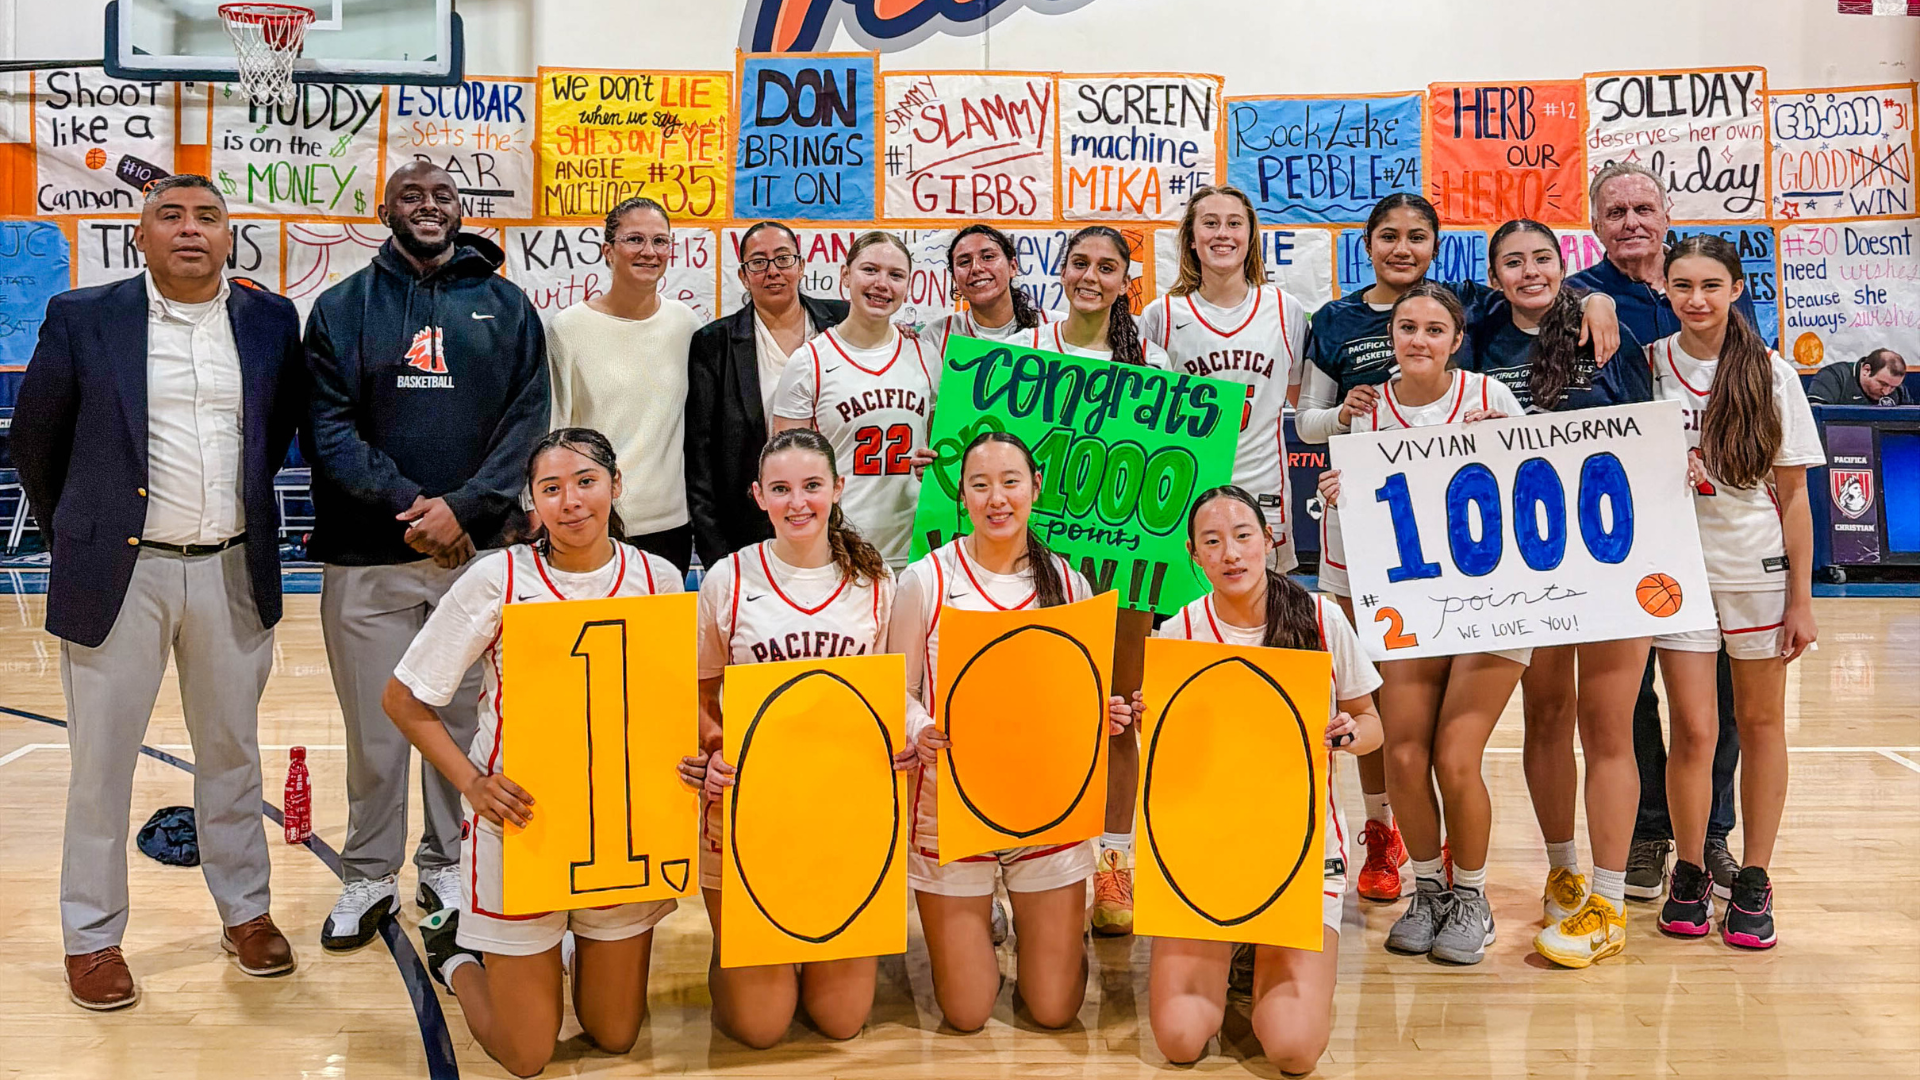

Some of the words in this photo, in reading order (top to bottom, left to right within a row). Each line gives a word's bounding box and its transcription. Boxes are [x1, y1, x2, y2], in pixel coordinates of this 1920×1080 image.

[397, 81, 525, 123] ESCOBAR
[660, 77, 712, 108] LIE
[755, 68, 857, 128] DON
[884, 75, 937, 135] SAMMY
[1077, 84, 1212, 132] SCREEN
[1595, 72, 1755, 122] SOLIDAY
[579, 105, 623, 125] when
[628, 112, 648, 125] we
[652, 111, 683, 138] say
[912, 81, 1051, 149] SLAMMY
[1452, 86, 1536, 141] HERB
[1542, 101, 1578, 121] #12
[1882, 98, 1909, 131] #31
[53, 115, 109, 147] like
[124, 115, 155, 139] a
[223, 130, 243, 150] is
[250, 137, 281, 153] on
[289, 137, 322, 157] the
[411, 121, 464, 147] sets
[472, 122, 511, 151] the
[556, 125, 623, 156] SHE'S
[628, 130, 655, 154] ON
[660, 115, 726, 162] FYE!
[1070, 125, 1199, 169] machine
[1588, 127, 1681, 150] deserves
[1688, 122, 1719, 143] her
[1726, 124, 1764, 142] own
[744, 132, 864, 169] BRINGS
[885, 143, 915, 176] #1
[1506, 143, 1560, 169] OUR
[121, 159, 151, 181] #10
[247, 161, 358, 210] MONEY
[413, 152, 502, 188] AR
[555, 158, 625, 181] ANGIE
[1257, 153, 1384, 203] PEBBLE
[1383, 157, 1418, 189] #24
[38, 184, 134, 212] Cannon
[545, 180, 645, 216] Martinez
[647, 163, 716, 217] #35
[752, 175, 781, 208] IT
[794, 172, 841, 206] ON
[912, 173, 1037, 217] GIBBS
[1068, 164, 1162, 215] MIKA
[1441, 169, 1541, 221] HERO
[1849, 187, 1908, 216] WIN
[1783, 227, 1838, 257] #30
[1844, 226, 1912, 256] Doesnt
[1783, 261, 1827, 281] need
[1839, 258, 1920, 281] wishes
[1854, 284, 1887, 305] she
[1787, 312, 1847, 334] always
[1184, 349, 1276, 381] PACIFICA
[1348, 341, 1386, 355] PACIFICA
[1356, 350, 1396, 364] BASKETB
[397, 375, 454, 389] BASKETBALL
[1491, 370, 1520, 382] ACIFICA
[835, 388, 926, 424] PACIFICA
[948, 347, 1224, 440] Congrats
[853, 423, 913, 476] 22
[1377, 433, 1477, 464] VIVIAN
[1498, 416, 1642, 451] VILLAGRANA
[1834, 455, 1868, 465] PACIFICA
[1031, 427, 1199, 537] 1000
[1035, 519, 1141, 551] points
[1375, 452, 1635, 584] 1000
[1834, 524, 1875, 532] CHRISTIAN
[1429, 583, 1588, 640] points
[1457, 625, 1481, 640] WE
[1491, 618, 1534, 638] LOVE
[1540, 613, 1580, 633] YOU!
[731, 668, 900, 944] 0
[944, 623, 1104, 839] 0
[1143, 655, 1316, 927] 0
